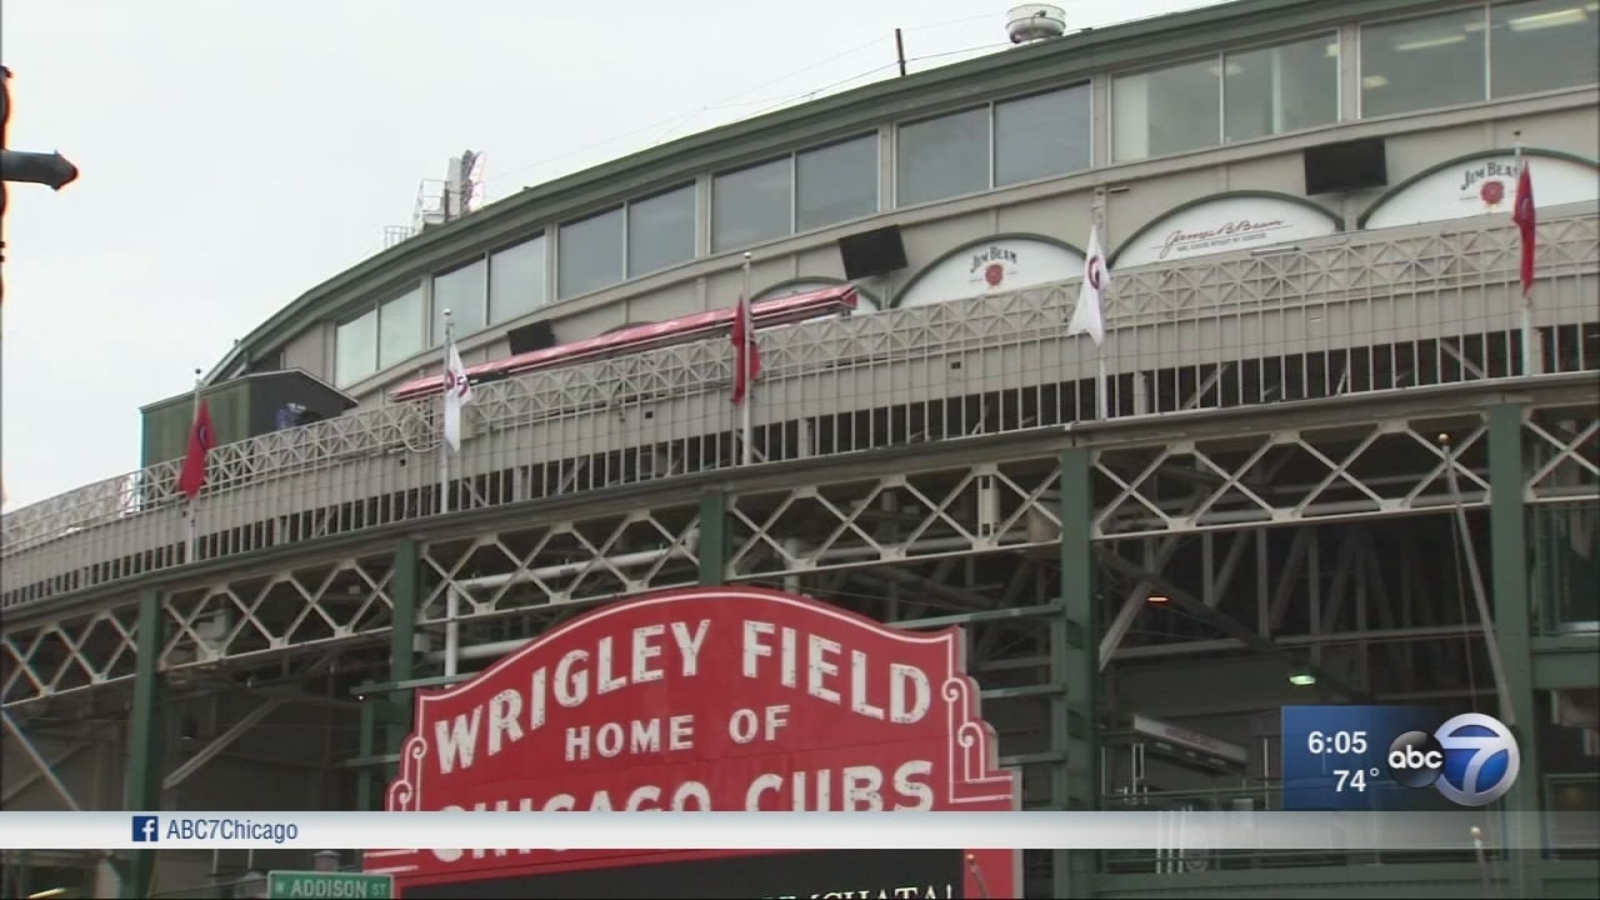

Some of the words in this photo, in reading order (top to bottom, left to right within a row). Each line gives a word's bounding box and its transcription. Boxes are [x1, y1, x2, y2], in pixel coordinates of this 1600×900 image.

[434, 619, 711, 774] WRIGLEY
[743, 619, 931, 724] FIELD
[565, 714, 694, 761] HOME
[729, 704, 790, 743] OF
[745, 760, 934, 812] CUBS
[290, 879, 367, 898] ADDISON
[371, 883, 386, 896] ST
